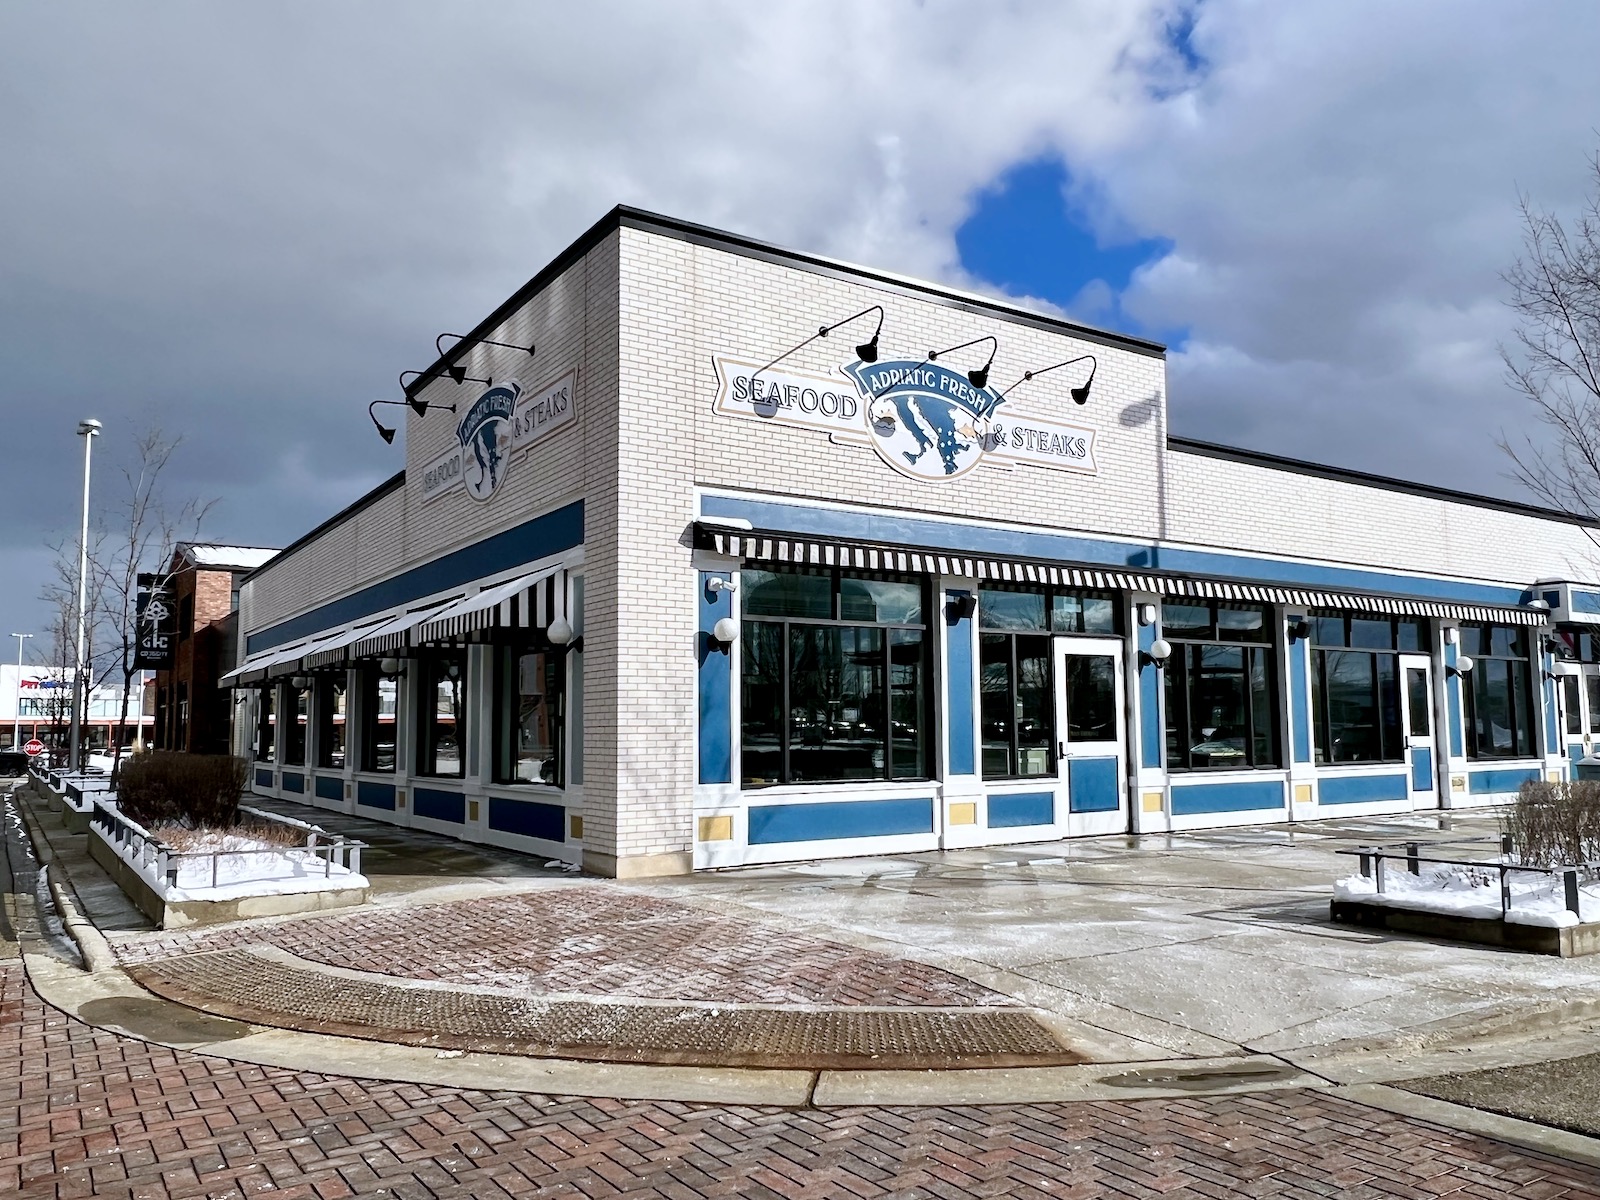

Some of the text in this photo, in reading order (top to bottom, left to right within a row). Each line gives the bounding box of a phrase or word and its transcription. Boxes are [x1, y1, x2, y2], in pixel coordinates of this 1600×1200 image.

[732, 375, 1086, 460] SEAFOOD & STEAKS
[870, 368, 986, 412] ADRIATIC FRESH
[424, 454, 460, 493] SEAFOOD
[524, 387, 568, 434] STEAKS
[25, 744, 43, 752] STOP
